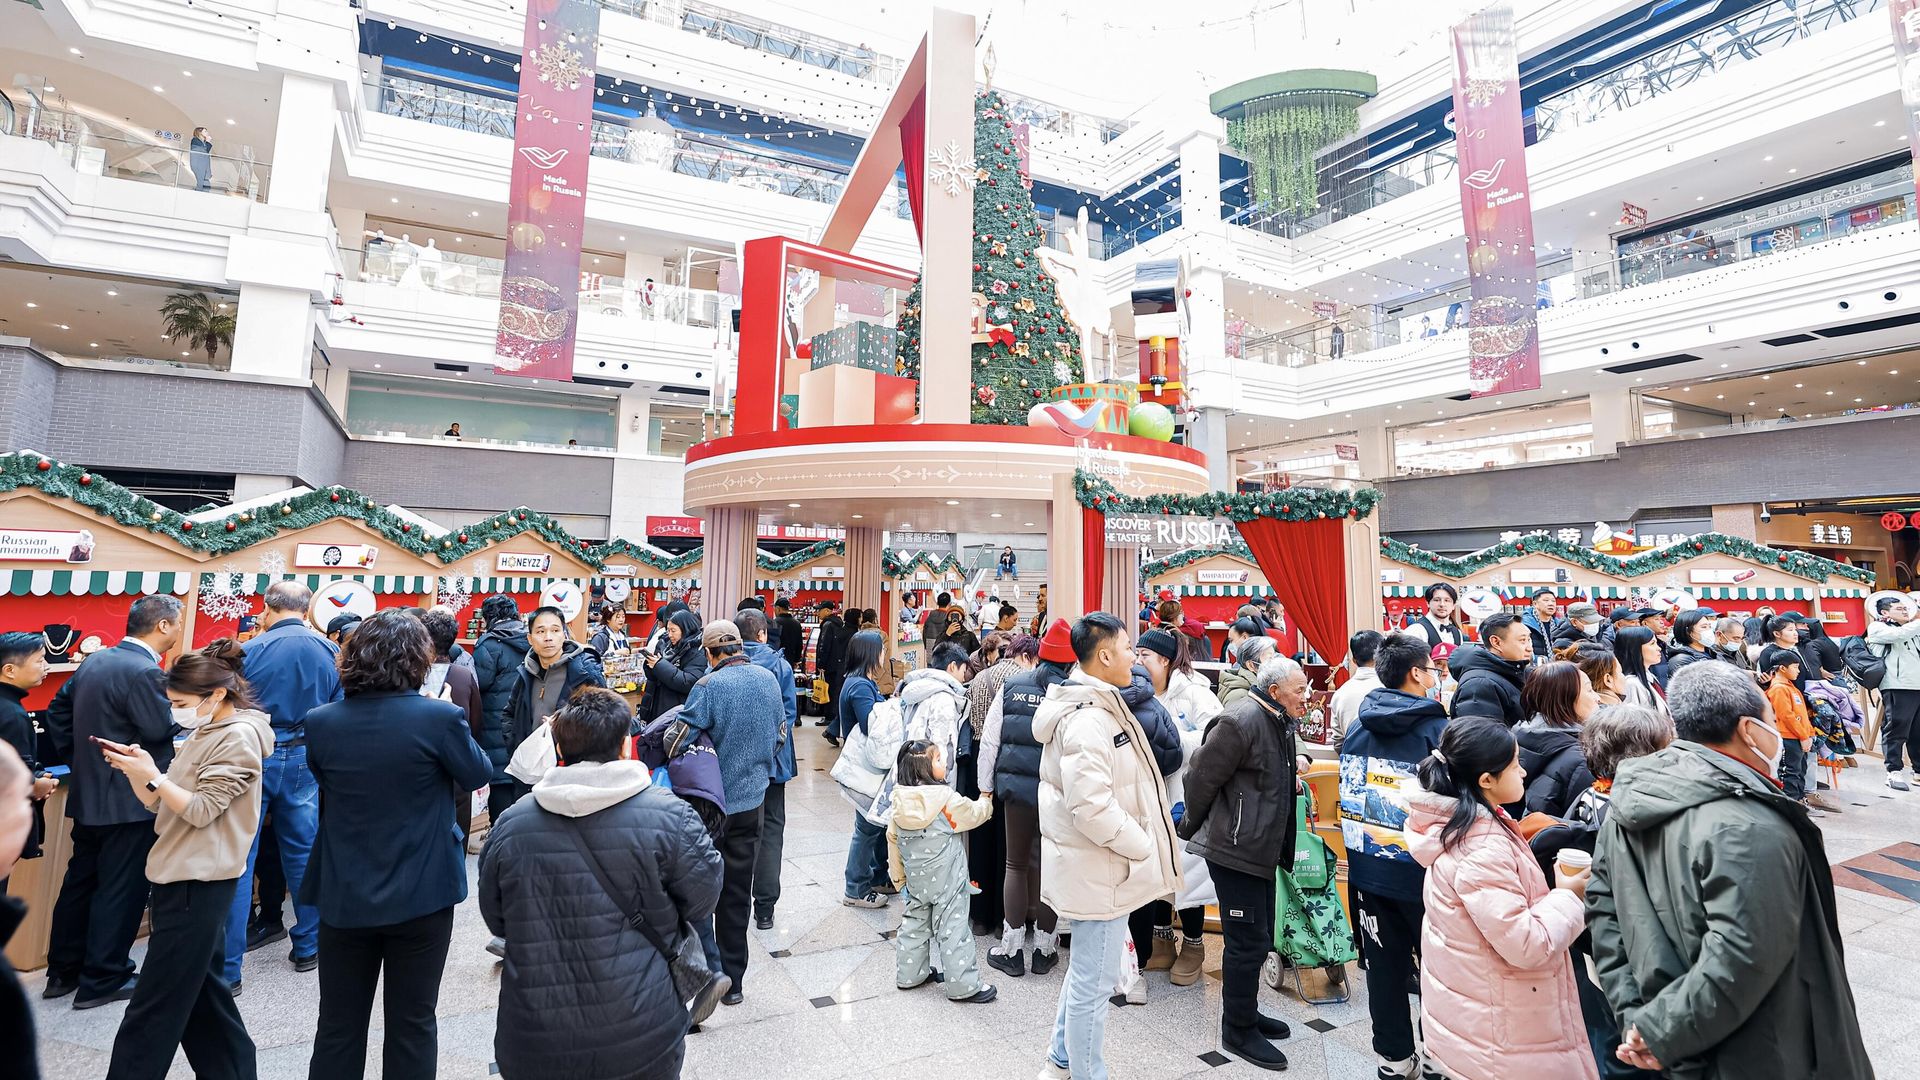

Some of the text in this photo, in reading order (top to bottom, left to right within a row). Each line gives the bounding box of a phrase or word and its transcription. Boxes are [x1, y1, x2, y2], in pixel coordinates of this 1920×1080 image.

[543, 174, 568, 185] Made
[553, 185, 582, 197] Russia
[1487, 187, 1509, 200] Made
[1497, 192, 1525, 206] Russia
[1093, 461, 1129, 476] Russia
[1104, 533, 1152, 543] HE TASTE OF
[1157, 520, 1233, 544] RUSSIA
[1811, 524, 1852, 544] 麦当劳
[1, 534, 48, 546] Russian
[0, 545, 60, 555] mammoth
[501, 556, 542, 568] HONEYZZ
